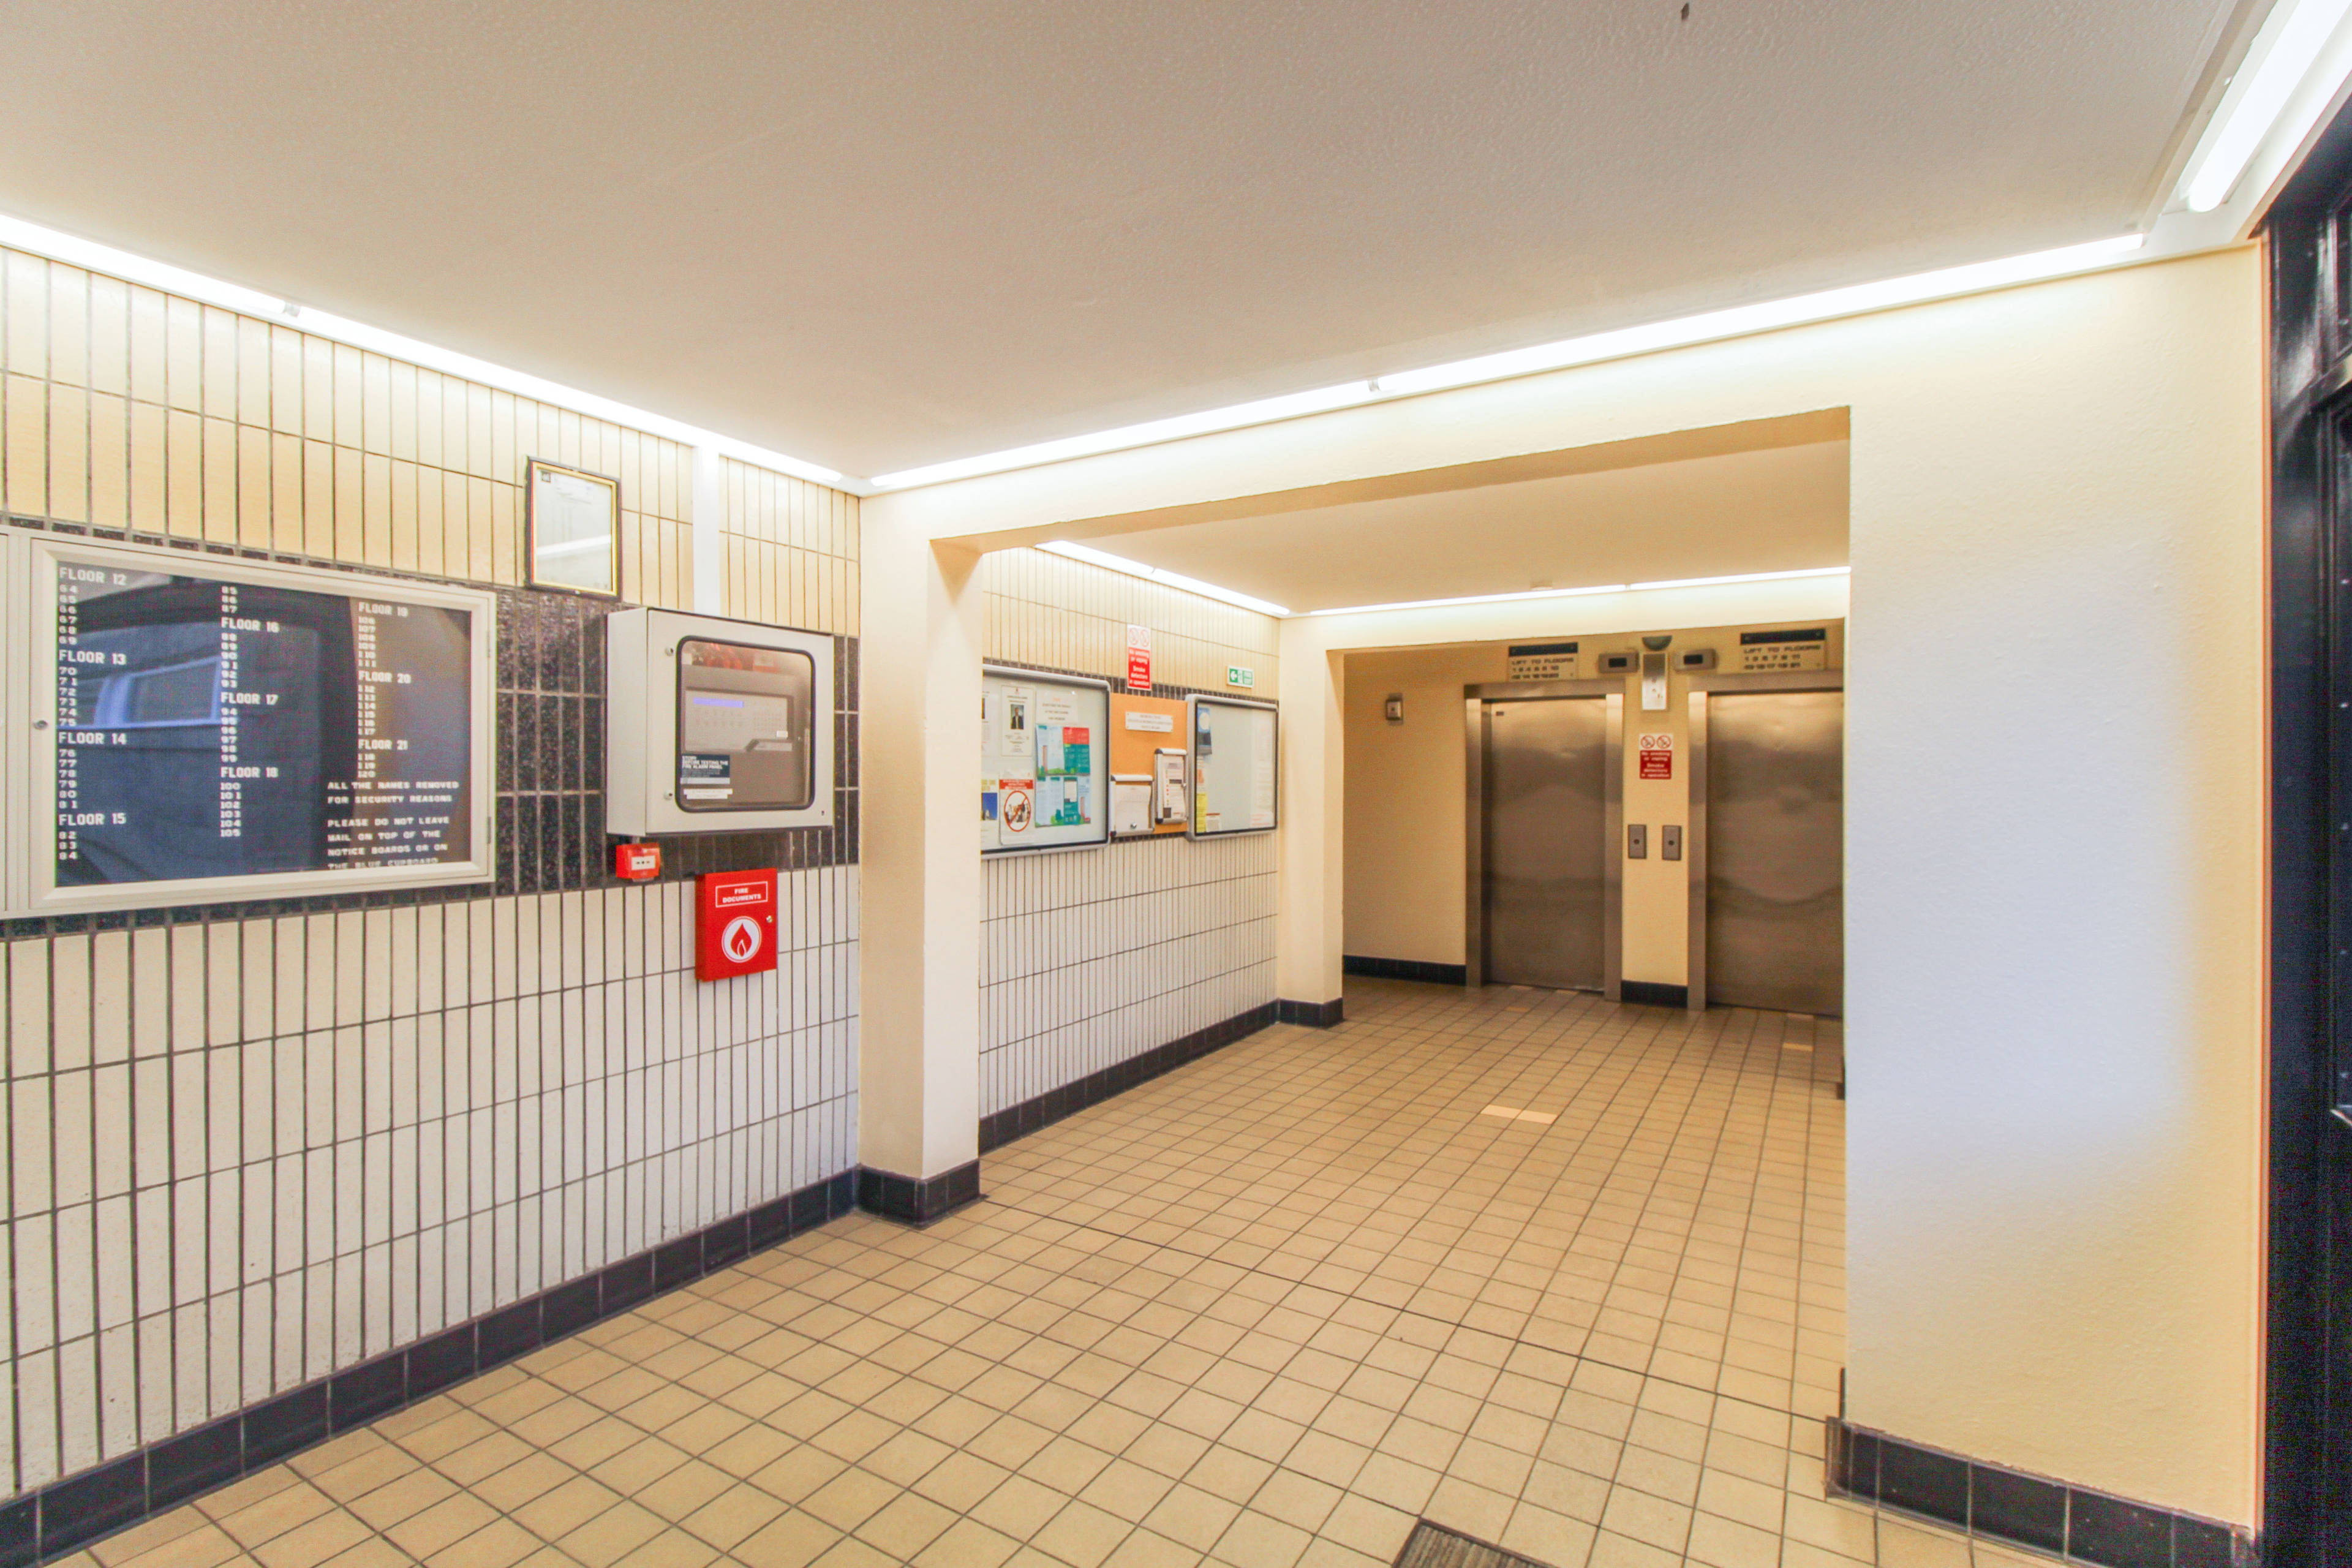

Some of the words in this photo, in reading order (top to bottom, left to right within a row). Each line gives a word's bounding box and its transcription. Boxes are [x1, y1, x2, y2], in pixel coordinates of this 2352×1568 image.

[59, 567, 105, 582] FLOOR
[113, 573, 126, 585] 12
[358, 601, 392, 615] FLOOR
[221, 617, 260, 631] FLOOR
[266, 621, 280, 633] 16
[59, 649, 105, 664] FLOOR
[111, 653, 126, 665] 13
[59, 667, 77, 676] 70
[59, 677, 77, 686] 71
[358, 670, 392, 683] FLOOR
[397, 673, 411, 684] 20
[59, 688, 77, 696] 72
[59, 698, 77, 706] 73
[221, 692, 260, 704] FLOOR
[266, 694, 279, 705] 17
[59, 707, 77, 716] 74
[59, 718, 77, 726] 75
[59, 732, 104, 745] FLOOR
[111, 733, 126, 745] 14
[358, 739, 392, 750] FLOOR
[59, 748, 77, 757] 76
[59, 759, 77, 767] 77
[59, 769, 77, 778] 78
[221, 767, 260, 778] FLOOR
[266, 767, 279, 778] 18
[59, 780, 77, 788] 79
[221, 782, 241, 791] 100
[59, 790, 77, 799] 80
[59, 813, 104, 826] FLOOR
[111, 812, 126, 824] 15
[328, 818, 369, 827] PLEASE
[221, 829, 241, 837] 105
[327, 847, 366, 856] NOTICE
[371, 845, 410, 854] BOARDS
[723, 894, 761, 903] DOCUMENTS
